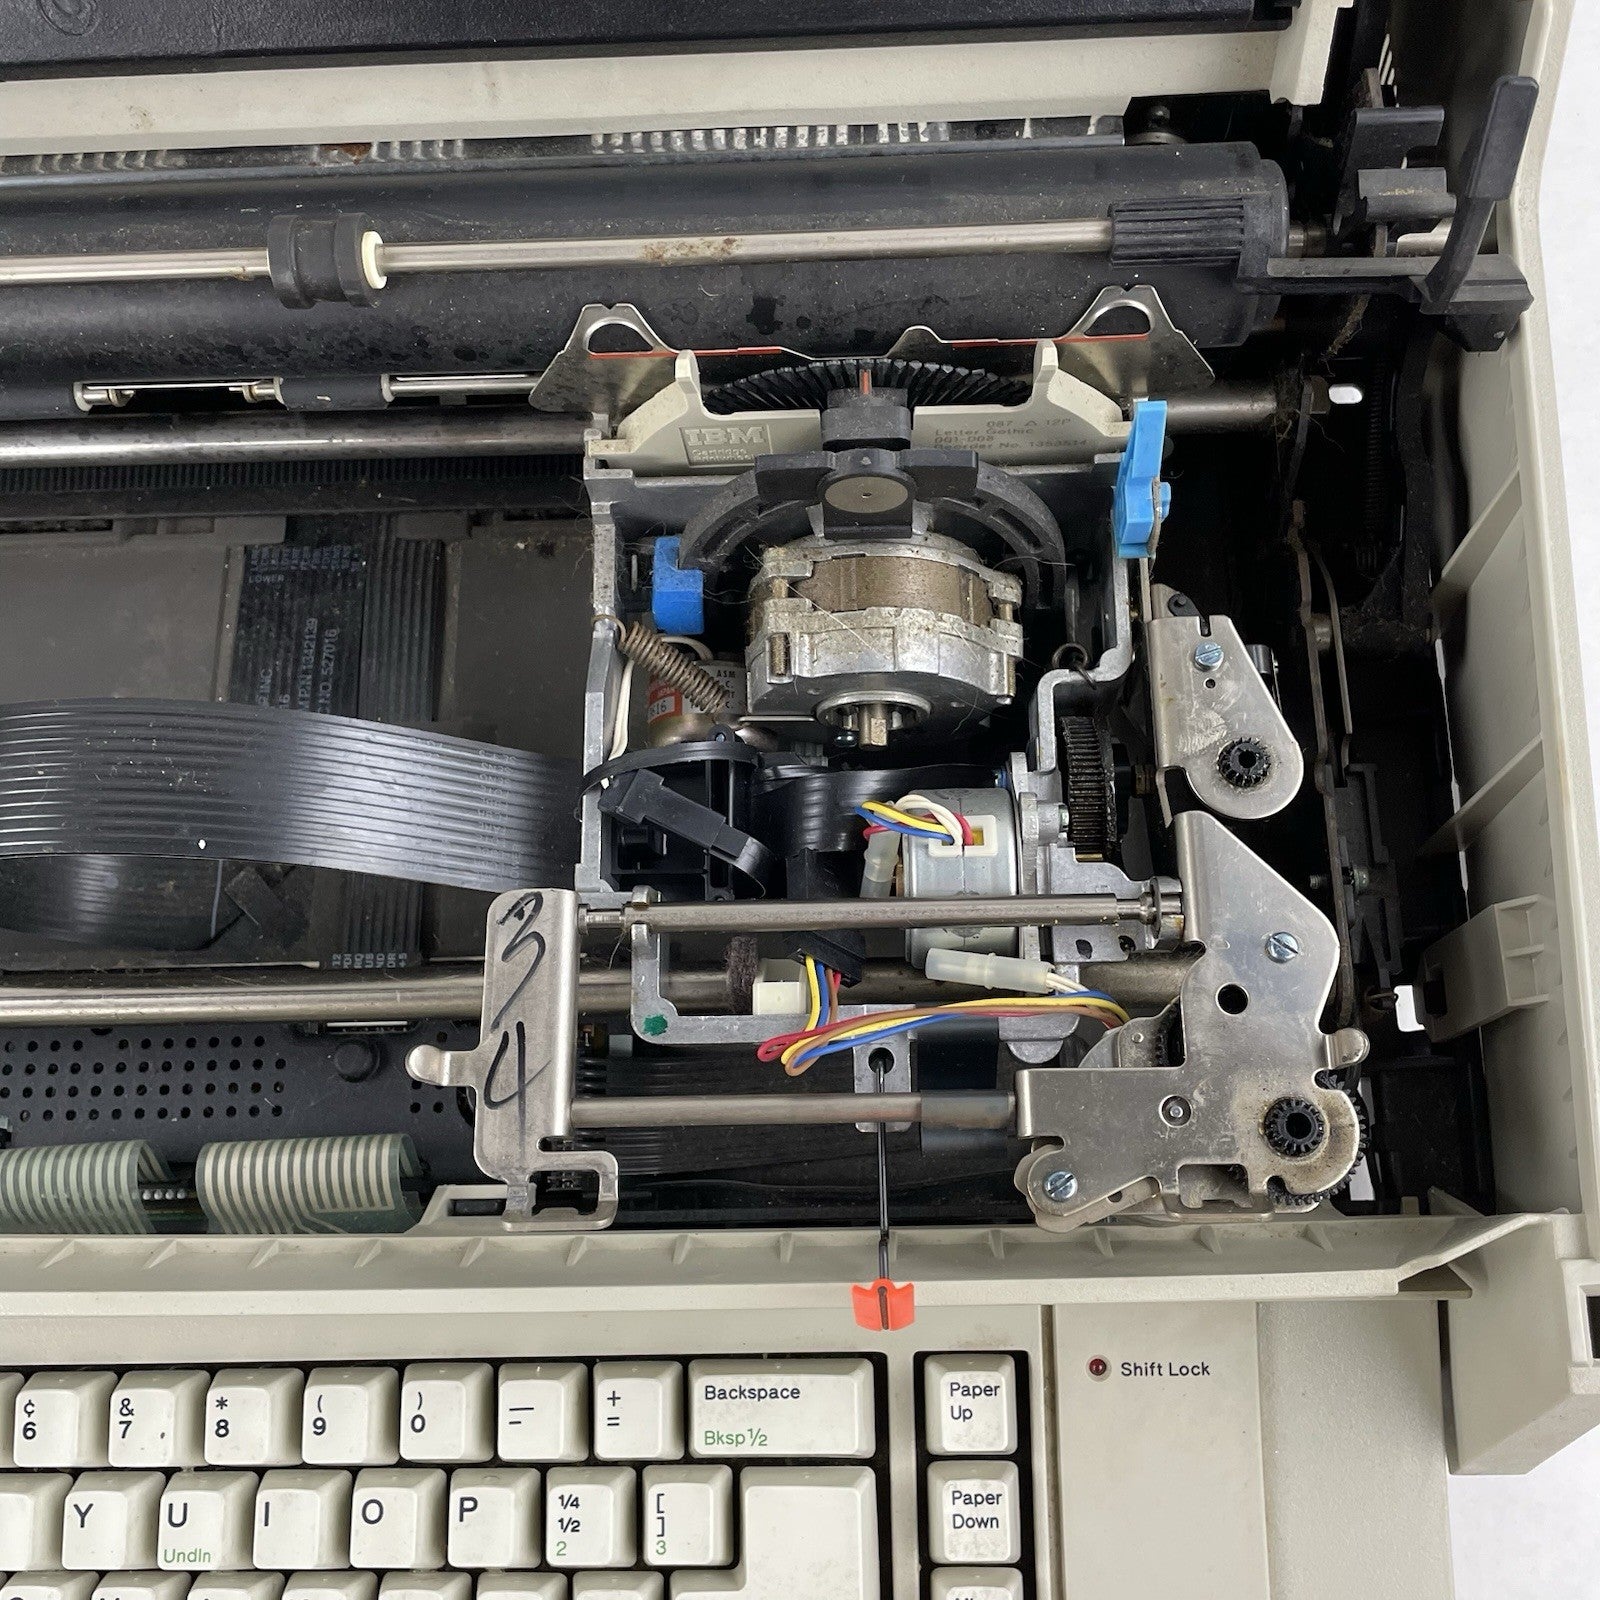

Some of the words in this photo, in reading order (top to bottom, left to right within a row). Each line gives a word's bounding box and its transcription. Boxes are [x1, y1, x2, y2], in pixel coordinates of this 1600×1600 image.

[684, 426, 764, 446] IBM
[717, 670, 736, 679] ASM
[490, 890, 546, 1034] 3
[1121, 1361, 1163, 1377] Shift
[1168, 1361, 1211, 1377] Lock
[606, 1390, 621, 1407] +
[704, 1384, 801, 1402] Backspace
[950, 1381, 1001, 1399] Paper
[119, 1397, 135, 1417] &
[950, 1405, 973, 1423] Up
[22, 1421, 37, 1441] 6
[118, 1420, 133, 1439] 7
[214, 1418, 230, 1438] 8
[312, 1416, 327, 1436] 9
[704, 1430, 746, 1448] Bksp
[951, 1490, 1003, 1508] Paper
[73, 1503, 94, 1529] Y
[167, 1502, 188, 1528] U
[263, 1501, 270, 1527] I
[361, 1498, 384, 1525] O
[459, 1496, 478, 1523] P
[952, 1513, 999, 1530] Down
[556, 1540, 567, 1557] 2
[655, 1539, 667, 1556] 3
